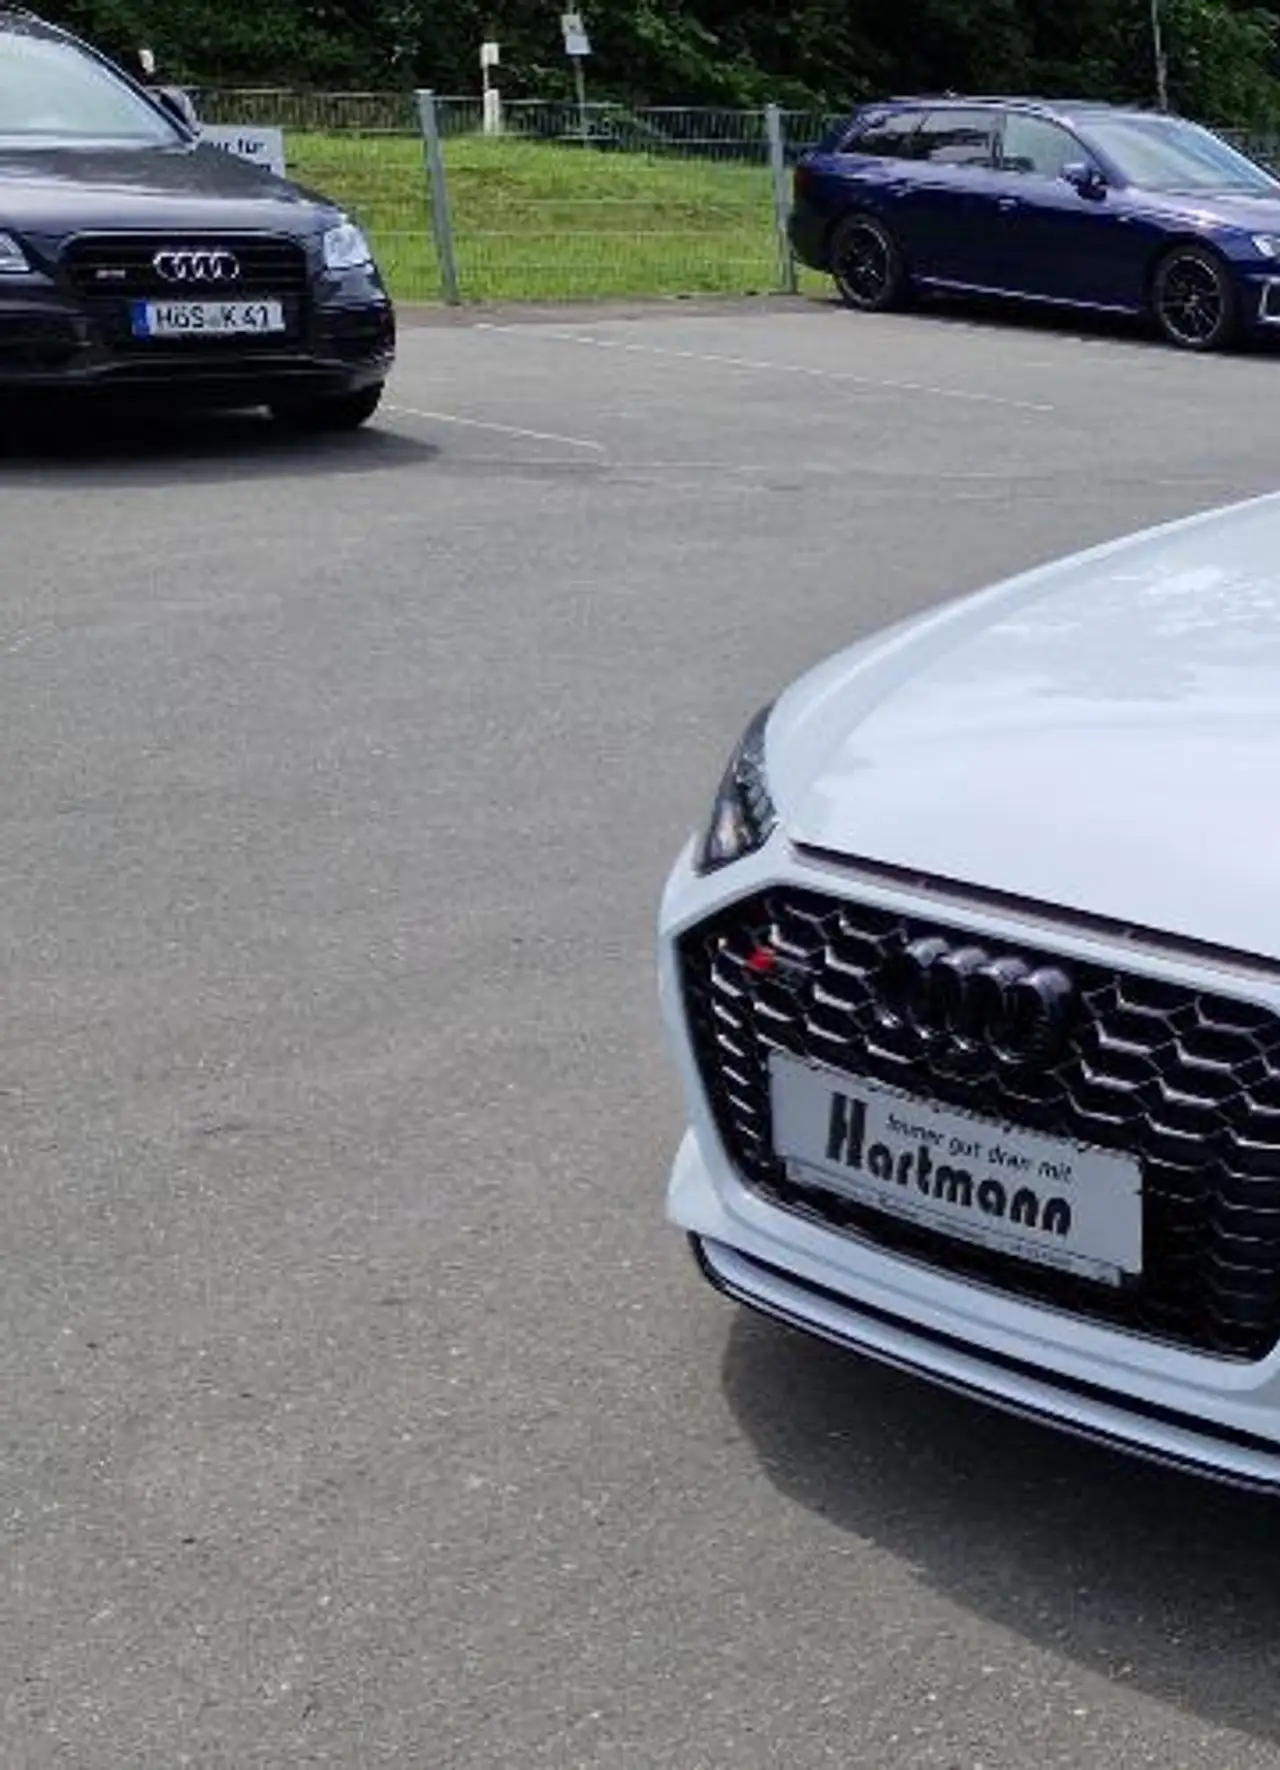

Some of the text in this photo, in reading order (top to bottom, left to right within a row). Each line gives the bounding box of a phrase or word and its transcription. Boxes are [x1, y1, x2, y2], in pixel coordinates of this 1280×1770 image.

[826, 1092, 1072, 1236] Hartmann
[949, 1137, 982, 1159] gut
[988, 1145, 1032, 1171] dran
[1038, 1159, 1072, 1183] mit
